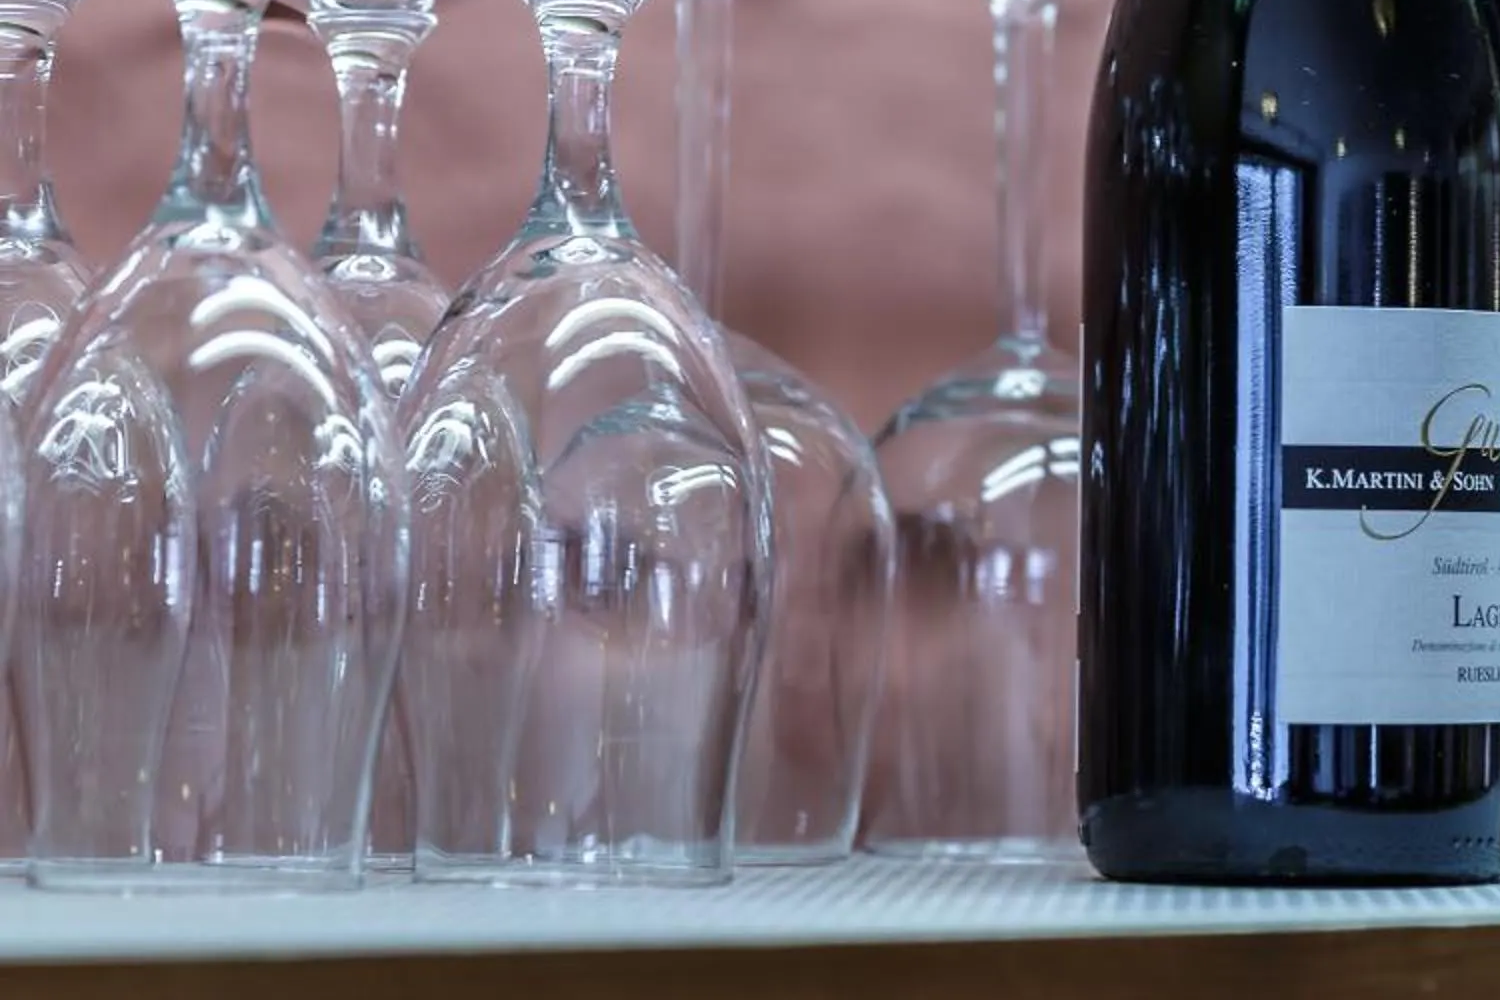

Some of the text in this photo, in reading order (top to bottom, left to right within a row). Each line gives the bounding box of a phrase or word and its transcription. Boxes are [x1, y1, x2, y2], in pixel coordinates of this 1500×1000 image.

[1305, 467, 1494, 491] K.MARTINI & SOHN
